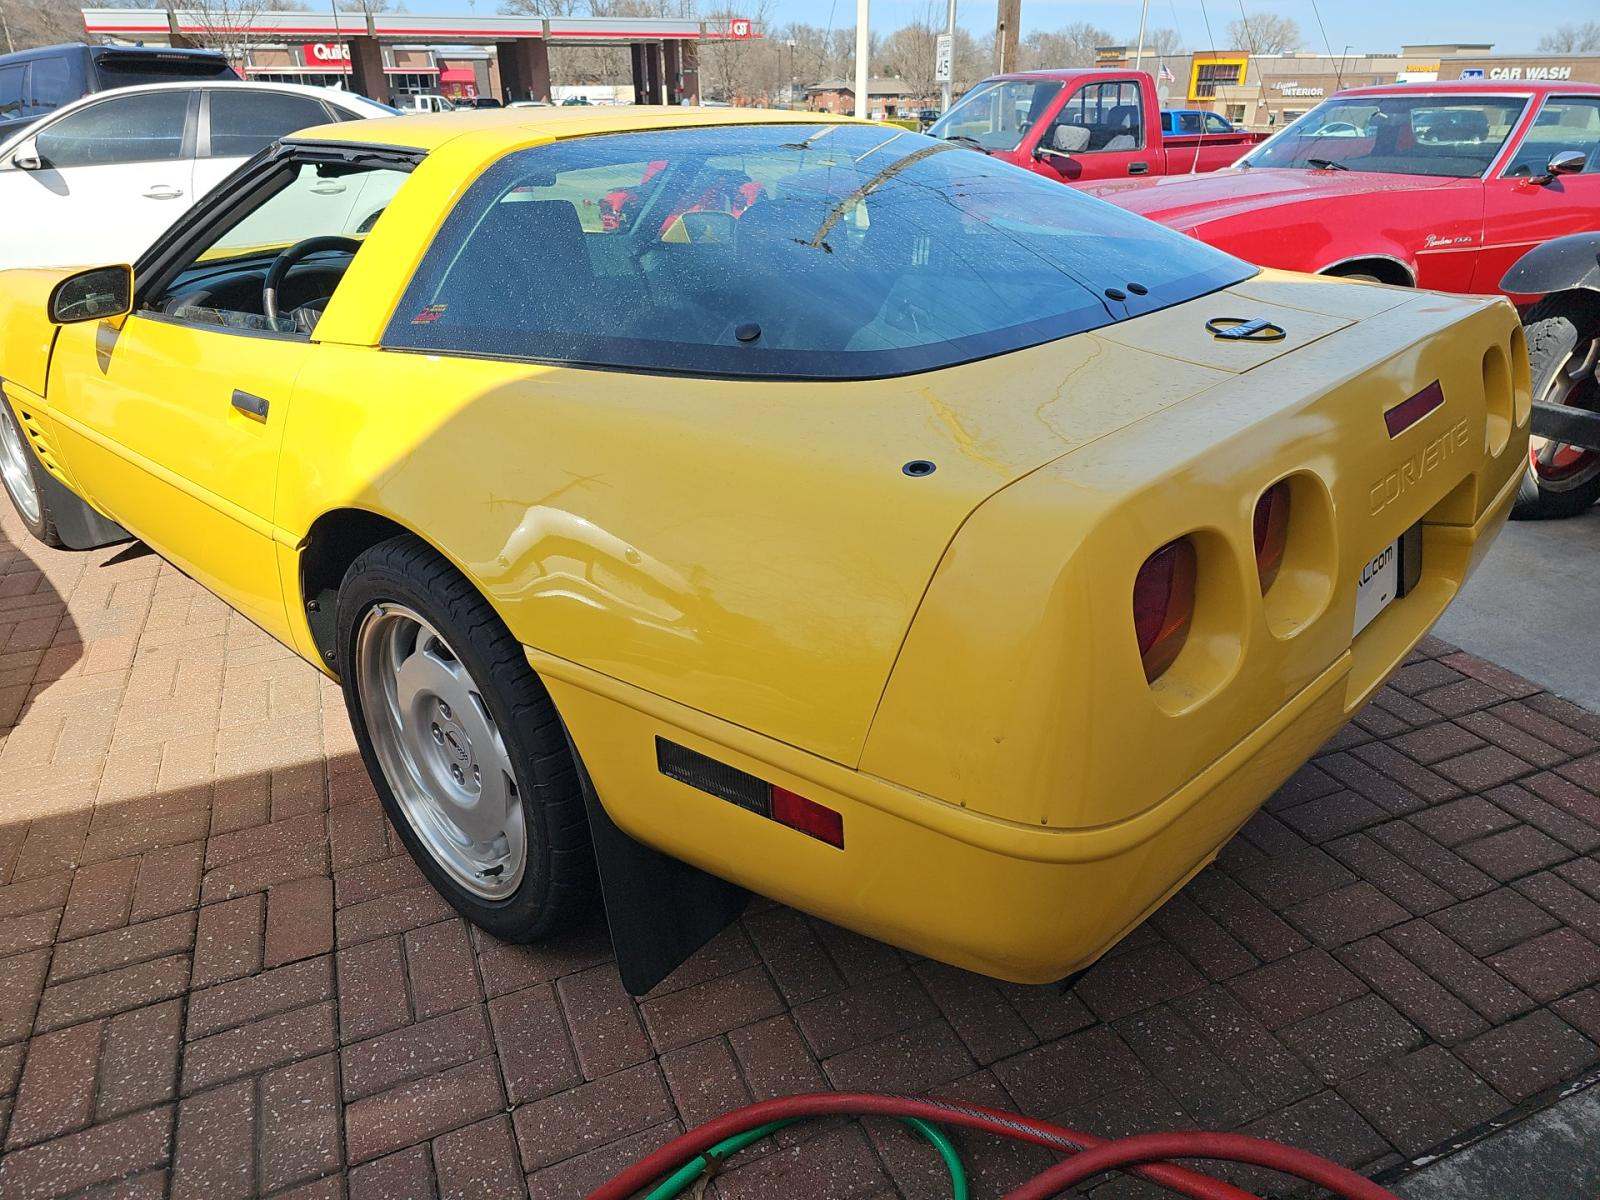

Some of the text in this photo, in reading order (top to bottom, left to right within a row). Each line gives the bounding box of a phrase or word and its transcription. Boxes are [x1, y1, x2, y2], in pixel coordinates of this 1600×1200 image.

[937, 60, 949, 76] 45
[1489, 67, 1521, 80] CAR
[1525, 66, 1571, 80] WASH
[1282, 87, 1324, 96] INTERIOR
[1367, 416, 1471, 517] CORVETTE
